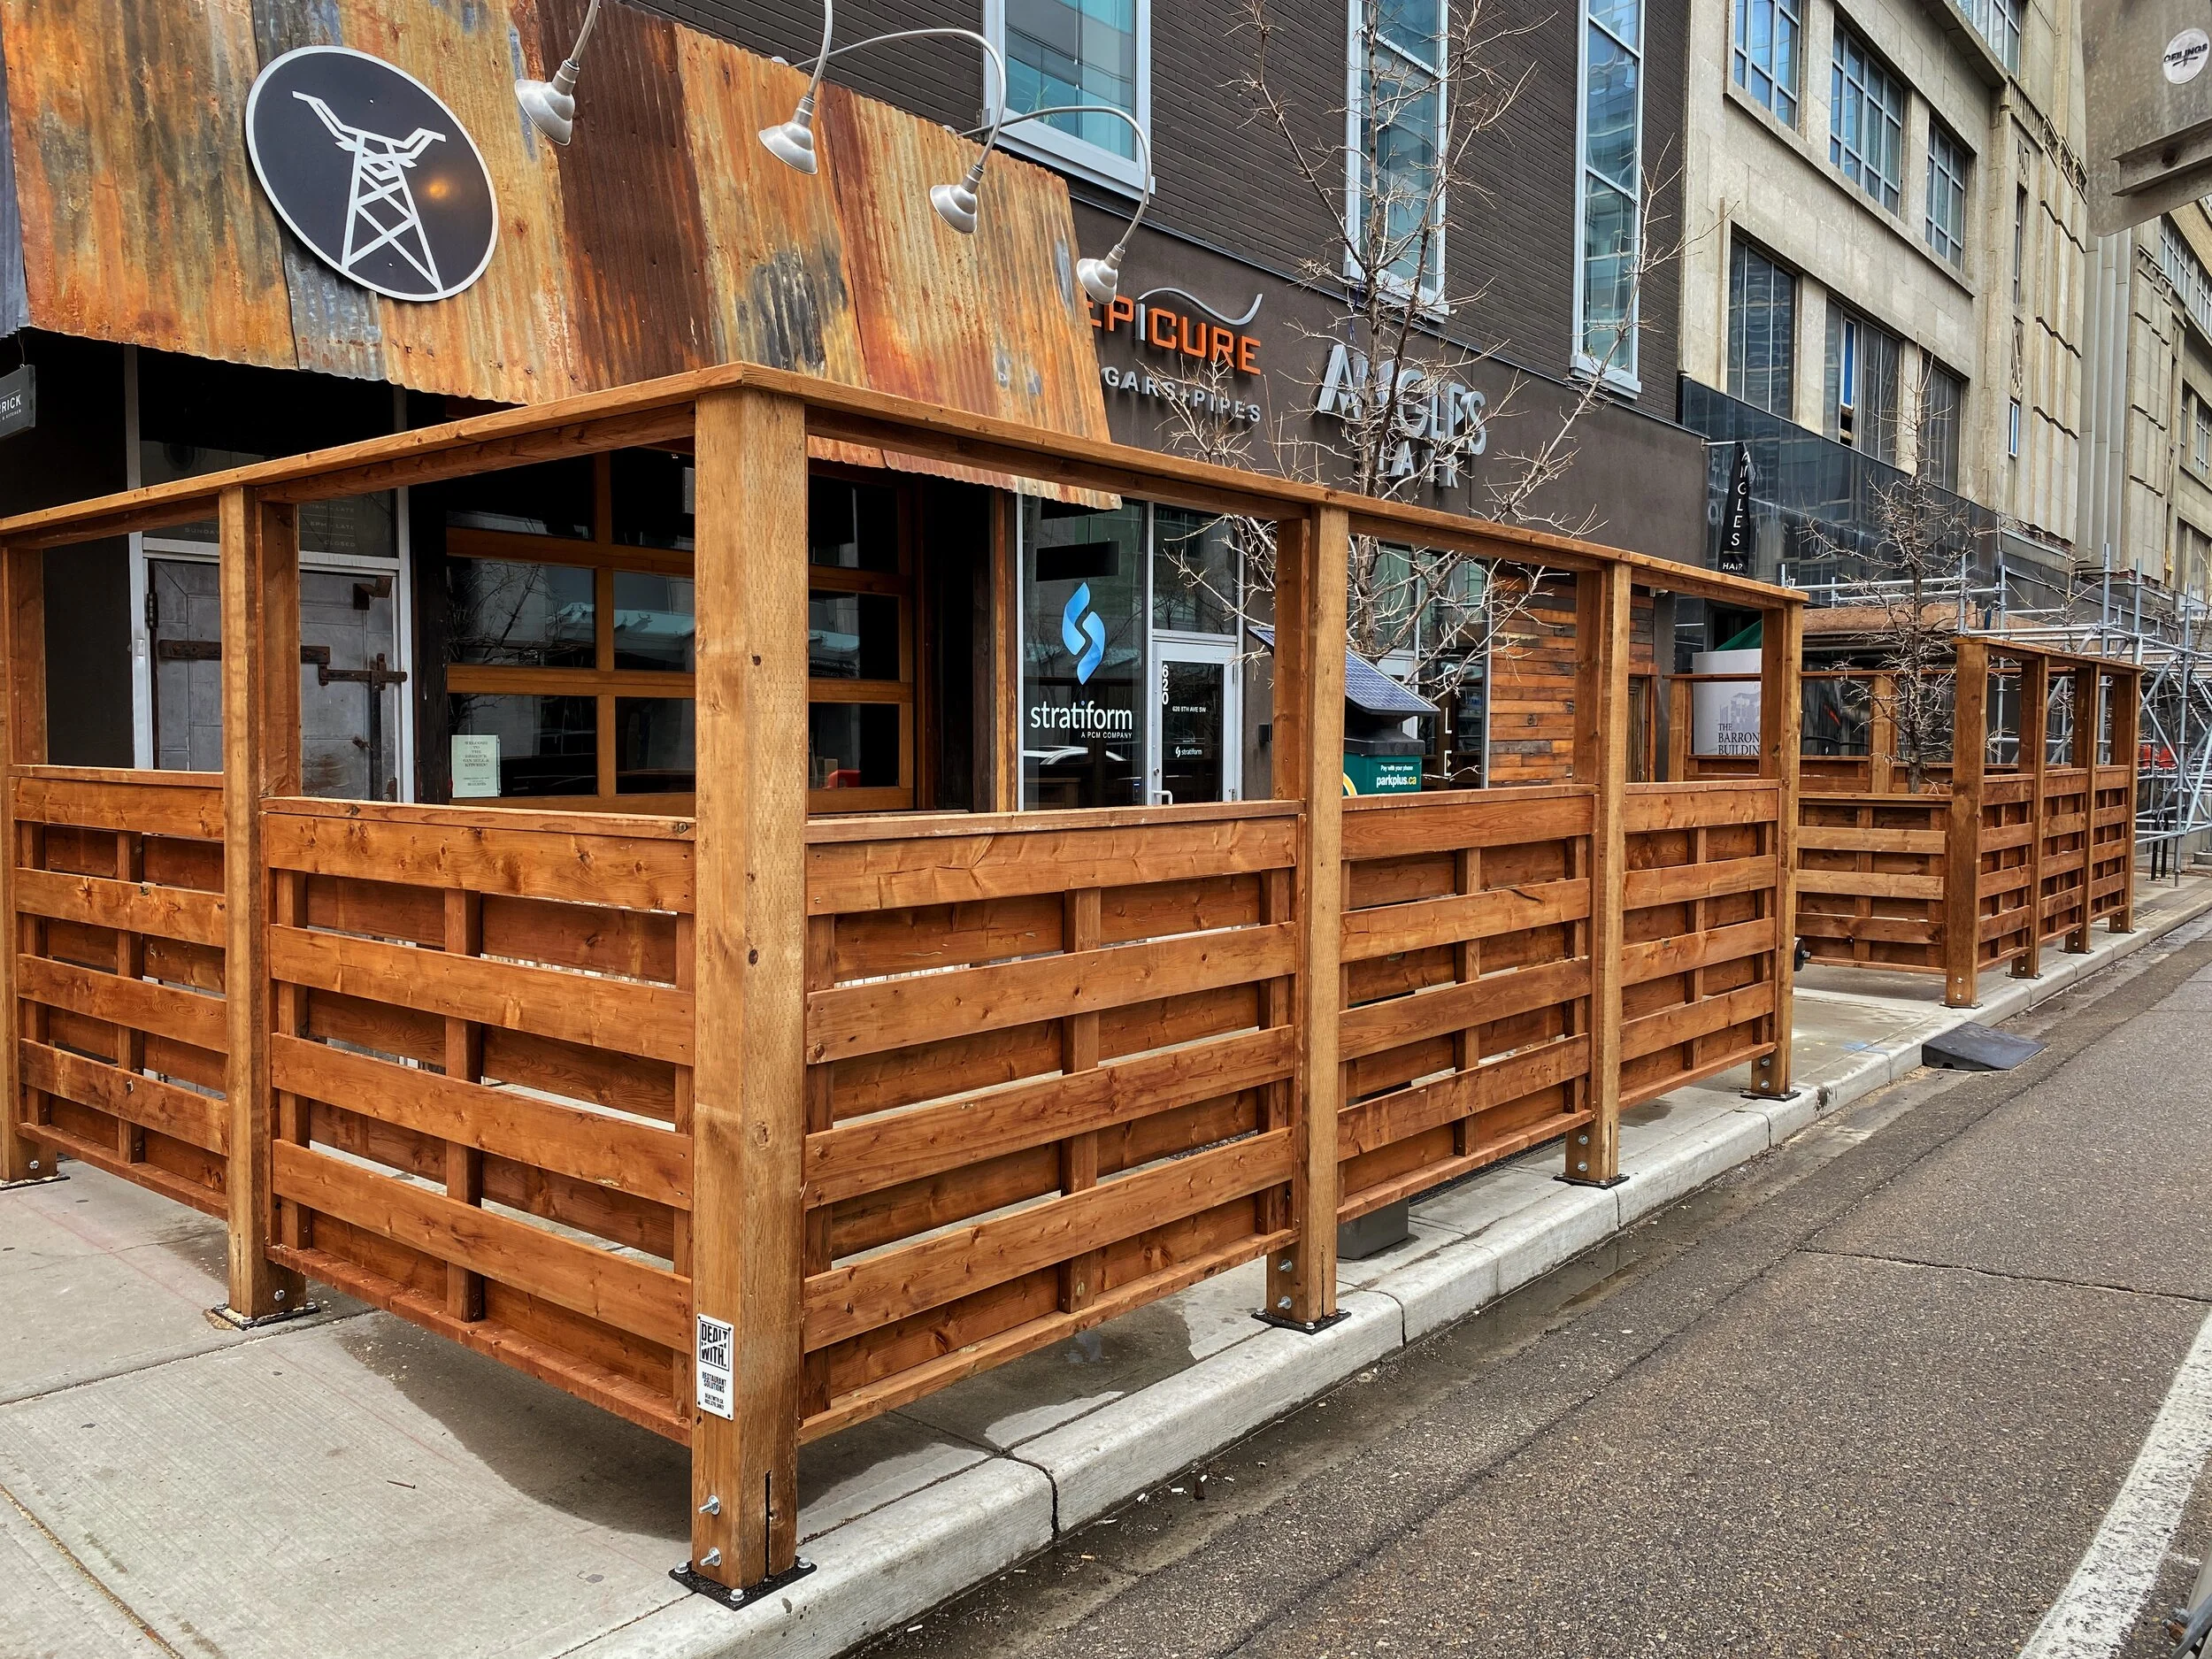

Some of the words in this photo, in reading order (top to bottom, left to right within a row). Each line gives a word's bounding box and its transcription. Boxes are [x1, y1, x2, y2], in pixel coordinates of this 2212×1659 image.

[0, 394, 21, 414] RICK
[1722, 562, 1743, 571] HAIR
[1030, 700, 1133, 730] stratiform
[1718, 723, 1732, 732] THE
[1718, 733, 1760, 743] BARRON
[1181, 747, 1203, 756] stratiform
[1376, 773, 1417, 788] parkplus.ca
